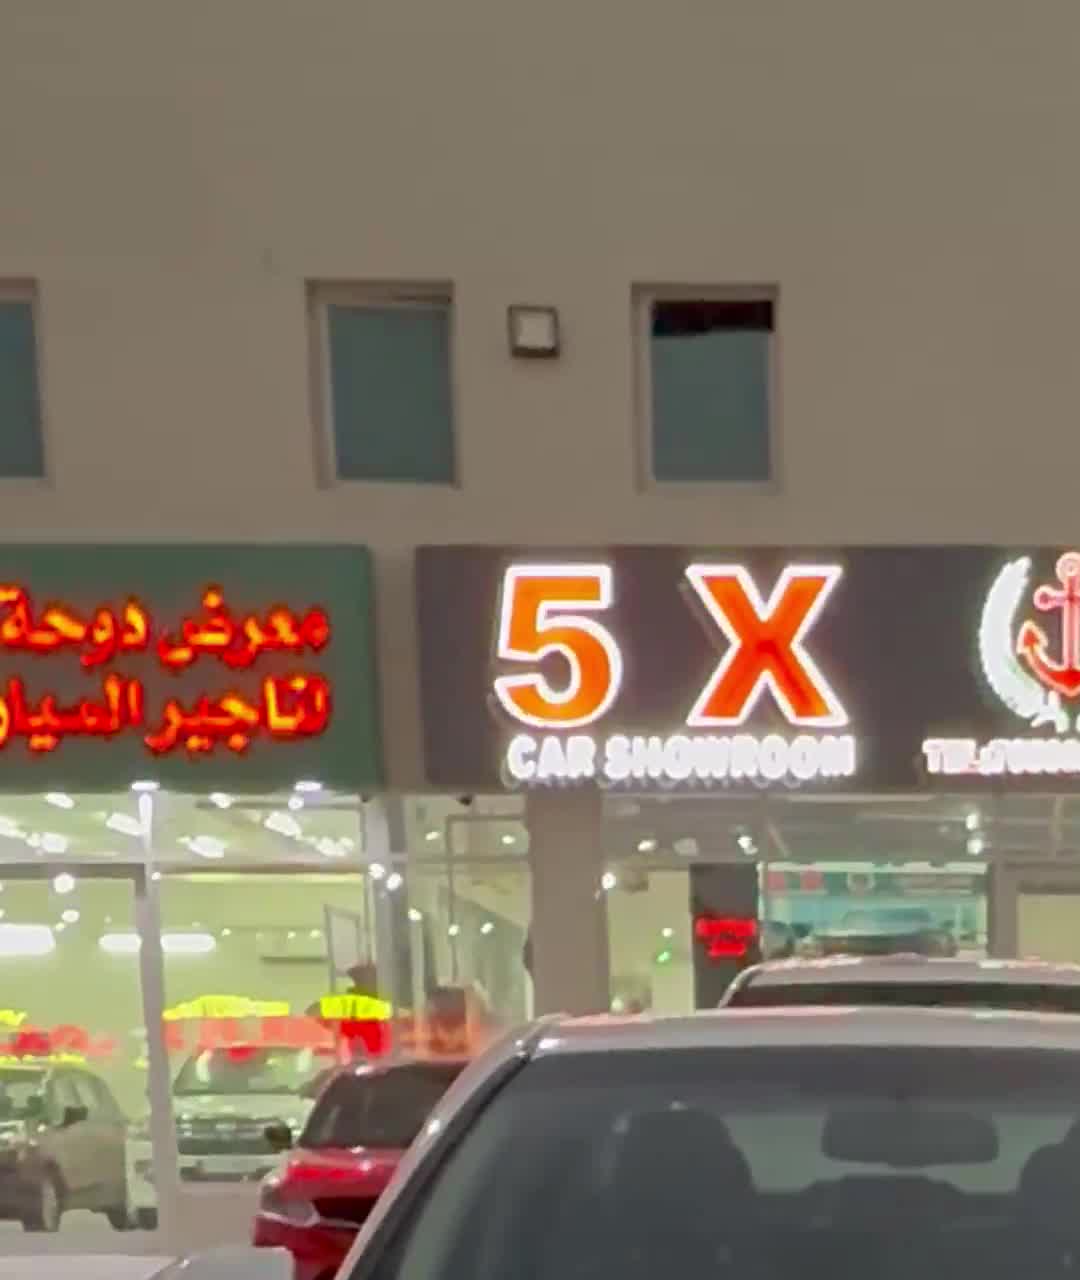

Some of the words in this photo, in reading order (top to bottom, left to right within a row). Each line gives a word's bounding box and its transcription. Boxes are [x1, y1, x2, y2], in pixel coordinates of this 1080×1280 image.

[158, 583, 330, 669] معرض
[495, 564, 622, 728] 5
[685, 564, 848, 726] X
[507, 735, 597, 780] CAR
[604, 735, 856, 780] SHOWROOM
